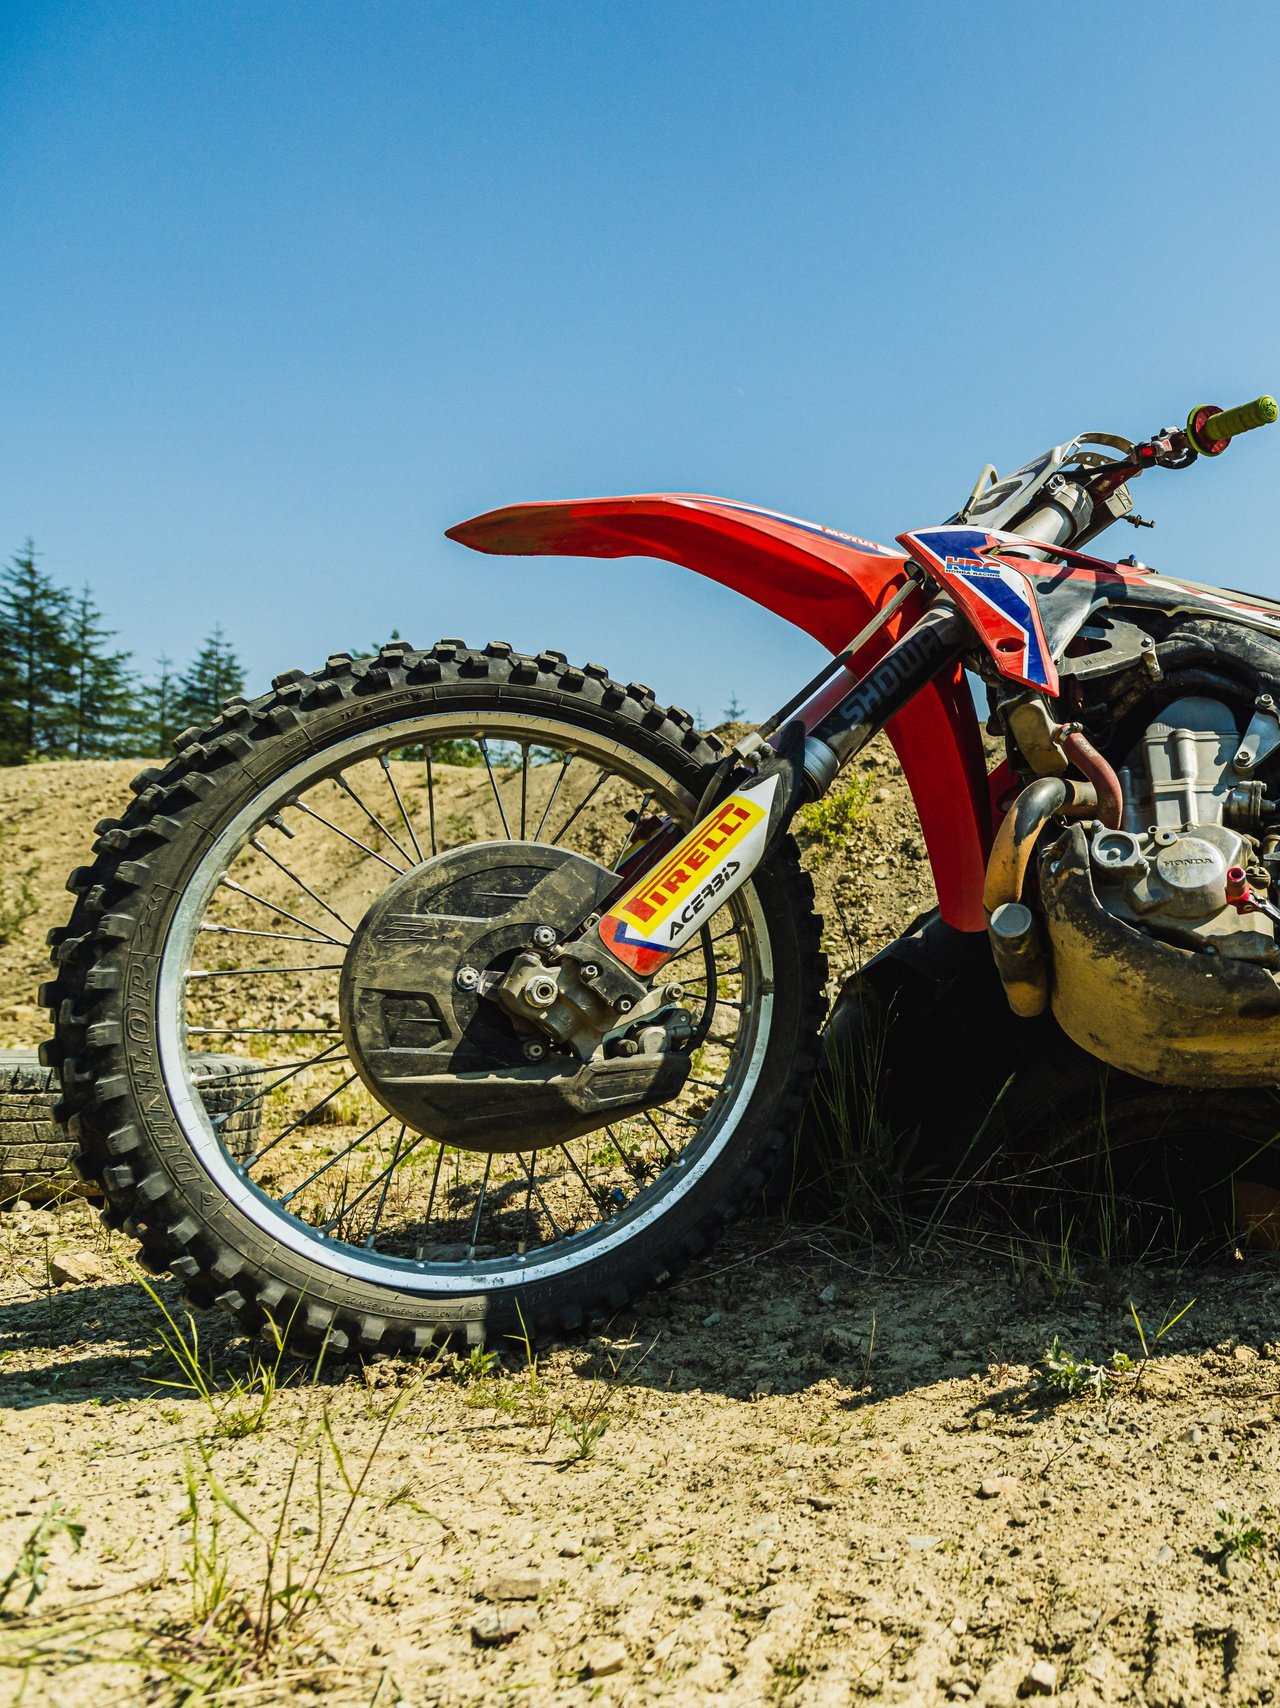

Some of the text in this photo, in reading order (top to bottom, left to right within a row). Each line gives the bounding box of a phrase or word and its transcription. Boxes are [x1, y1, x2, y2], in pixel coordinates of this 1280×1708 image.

[824, 528, 878, 549] MOTUL
[946, 557, 1001, 573] HRC
[839, 626, 942, 721] SHOWA
[621, 803, 751, 923] PIRELLI
[1162, 858, 1214, 867] HONDA
[125, 962, 206, 1186] DUNLOP
[435, 1310, 451, 1318] NOT
